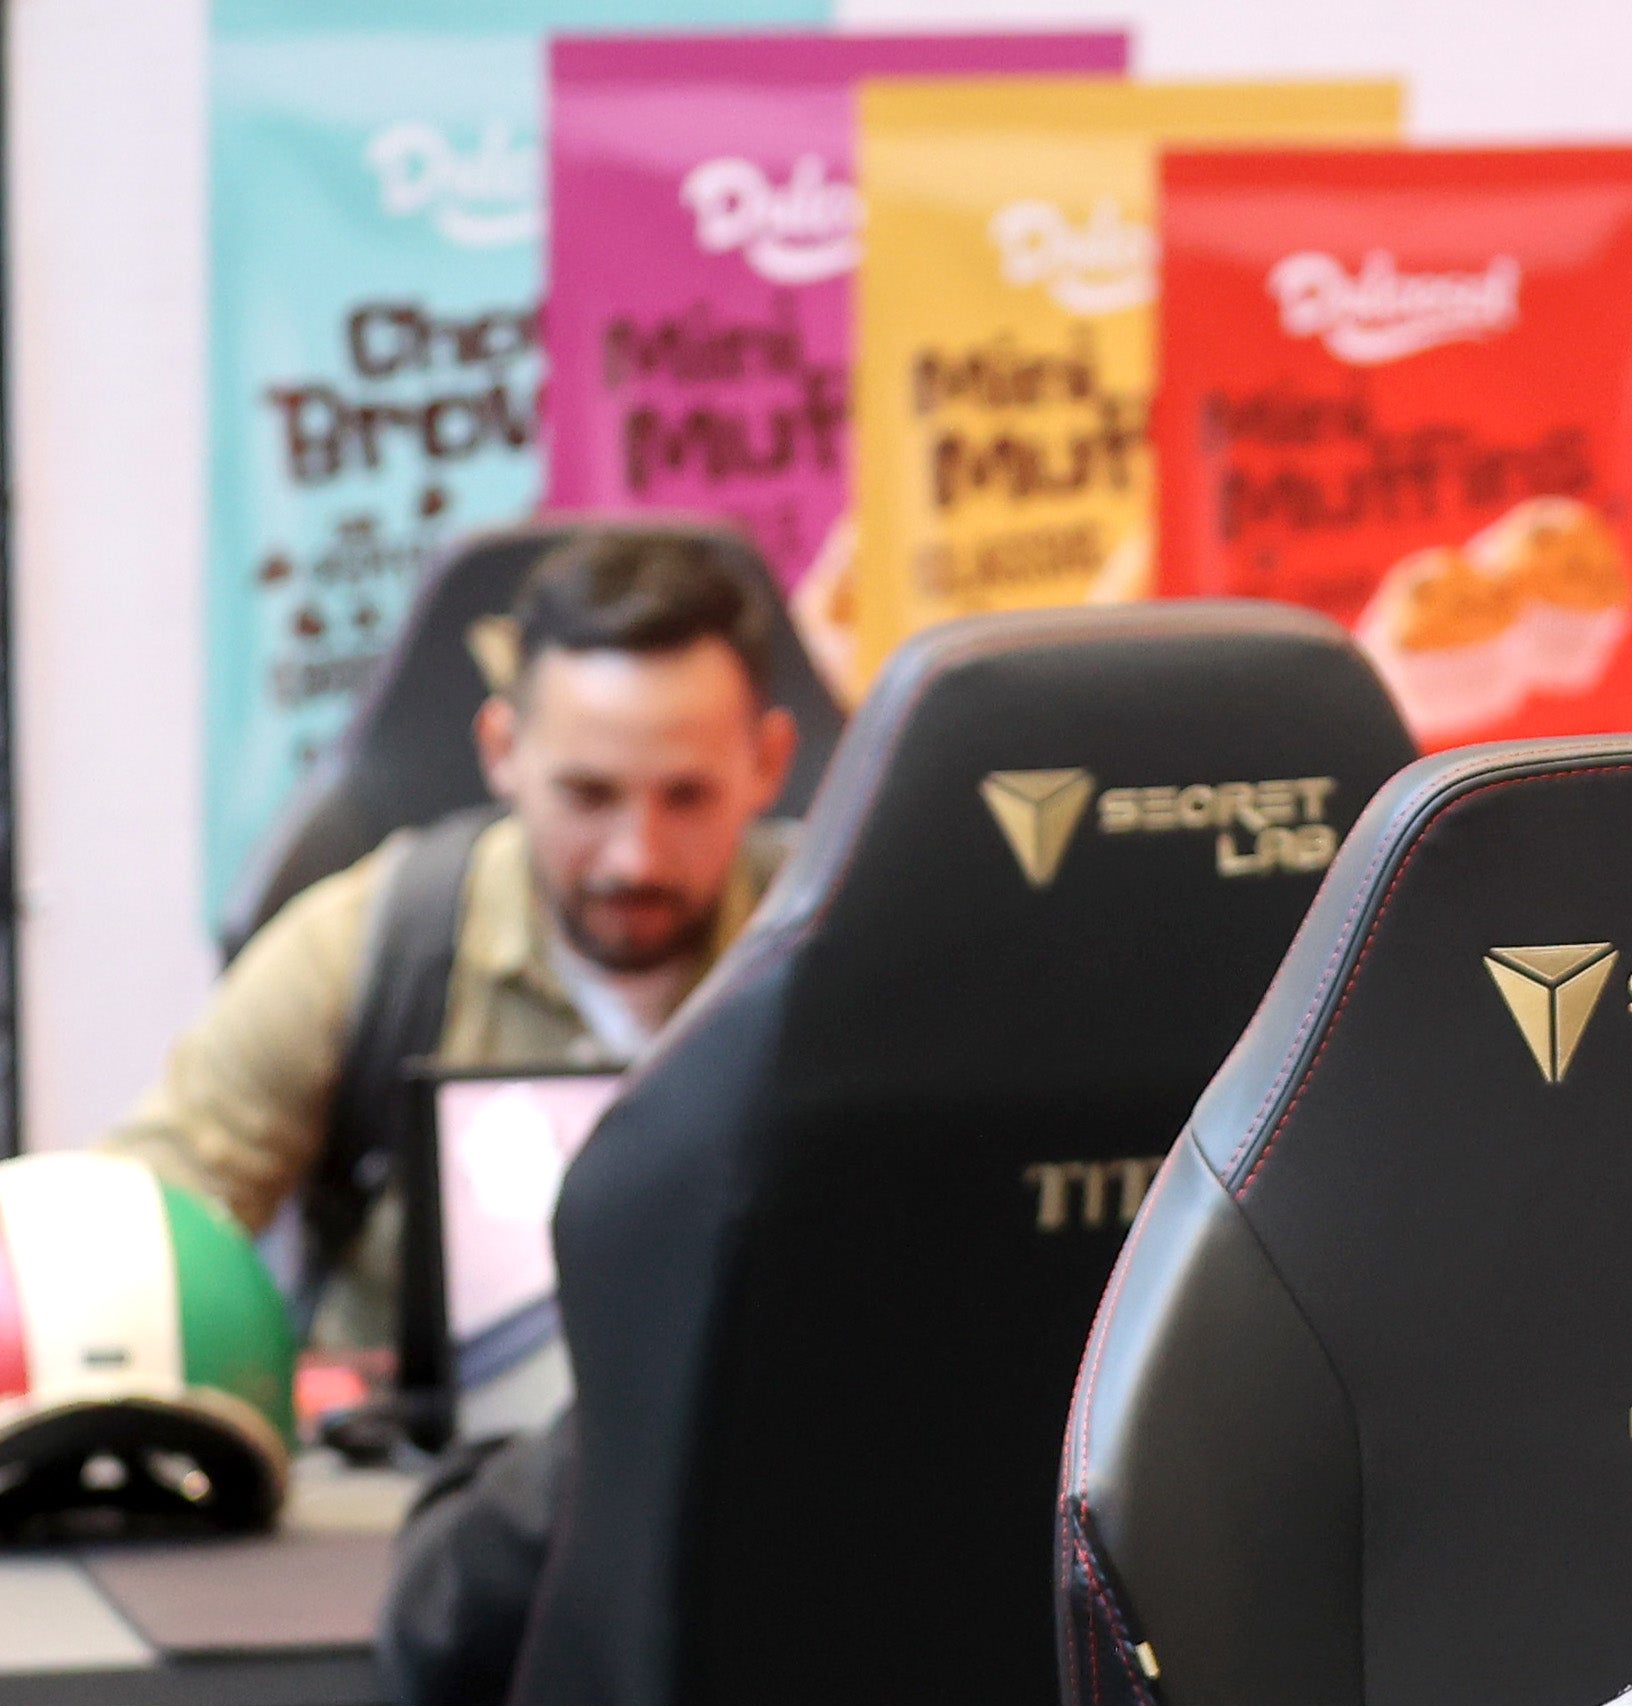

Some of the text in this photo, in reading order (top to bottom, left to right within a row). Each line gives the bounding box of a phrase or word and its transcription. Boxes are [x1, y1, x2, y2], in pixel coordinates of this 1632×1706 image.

[345, 301, 544, 379] Cho
[1100, 776, 1337, 835] SECRET
[1216, 824, 1338, 878] LAB
